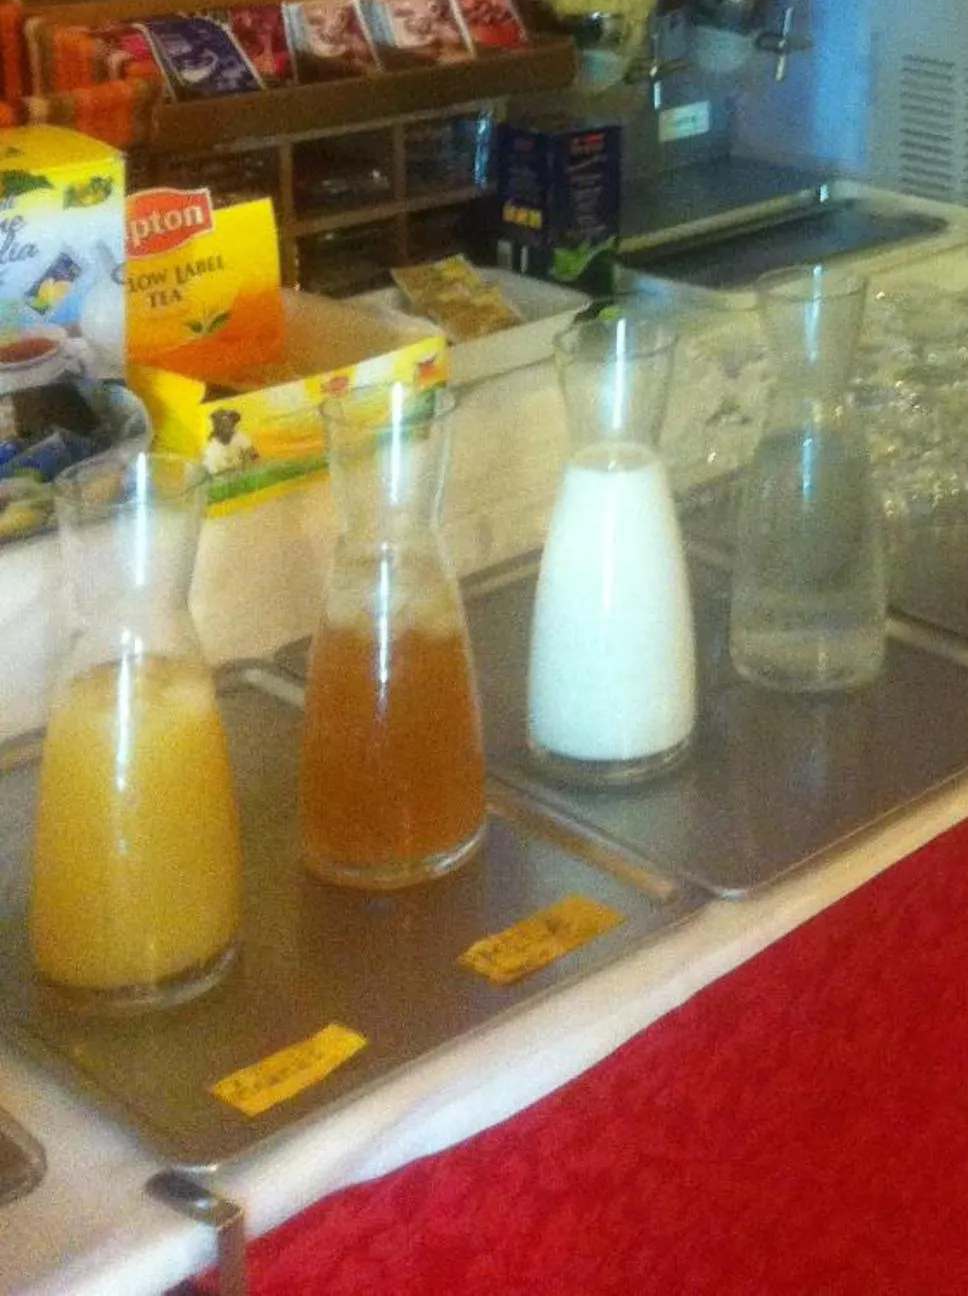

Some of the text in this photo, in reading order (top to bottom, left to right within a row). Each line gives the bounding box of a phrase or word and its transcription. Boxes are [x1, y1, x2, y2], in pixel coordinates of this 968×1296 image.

[130, 205, 203, 247] pton
[127, 254, 224, 293] LOW LABEL
[149, 288, 182, 309] TEA
